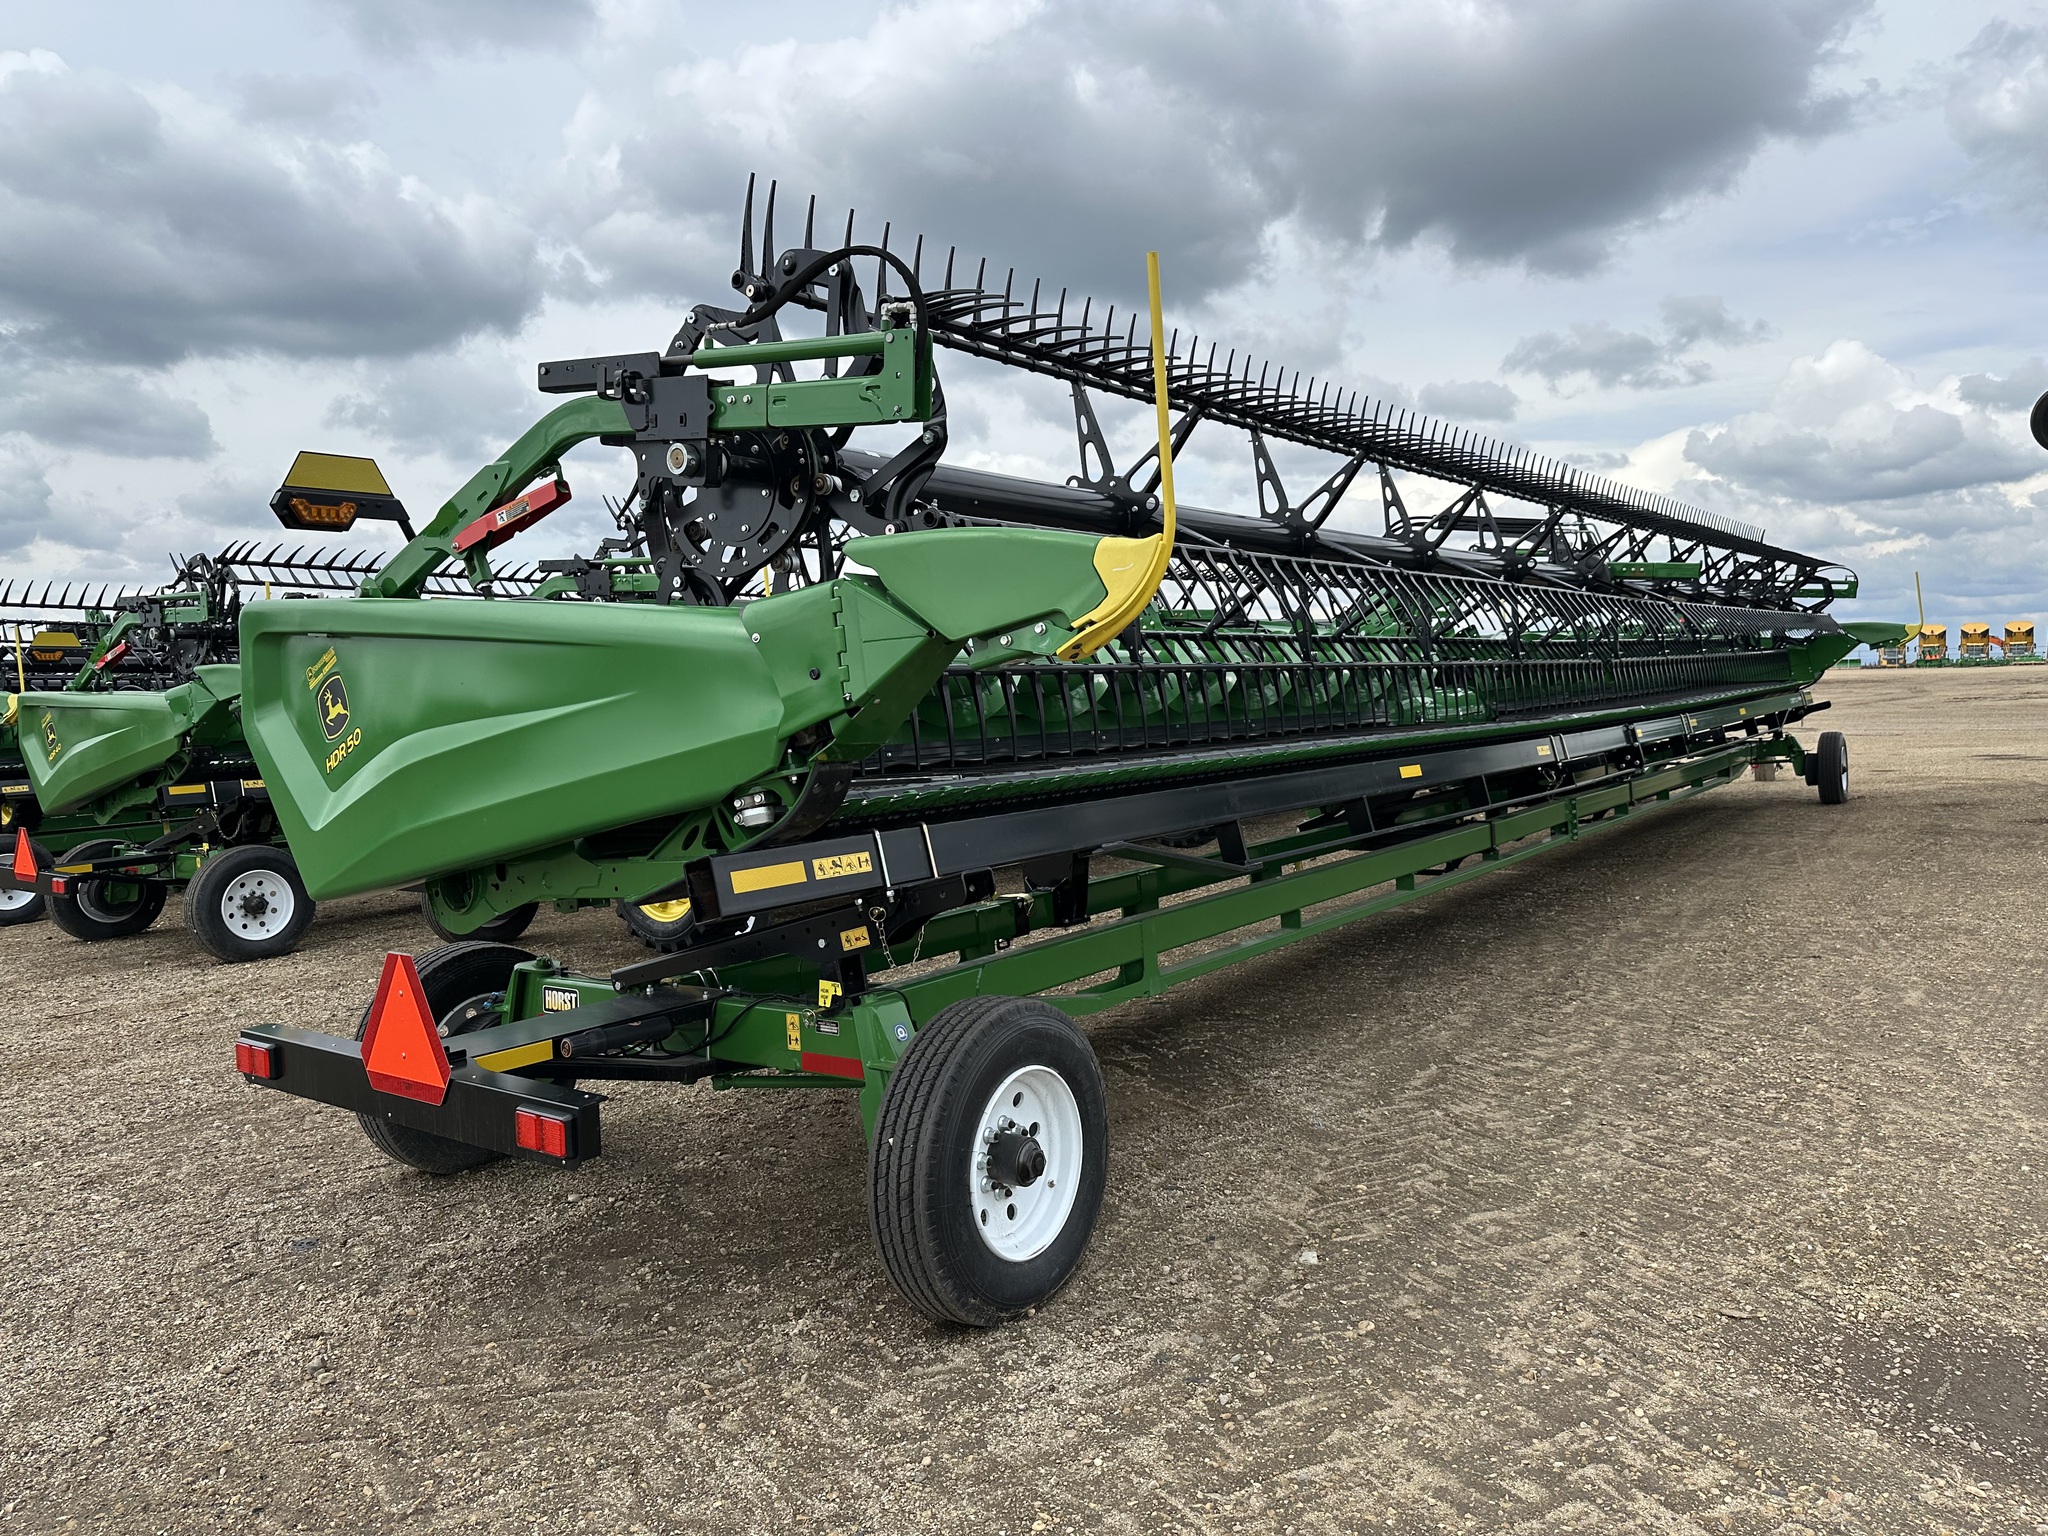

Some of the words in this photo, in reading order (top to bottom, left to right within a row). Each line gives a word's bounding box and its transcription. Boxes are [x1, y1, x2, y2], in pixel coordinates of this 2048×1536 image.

[325, 742, 347, 774] HDR
[347, 727, 362, 754] 50
[545, 989, 577, 1012] HORST
